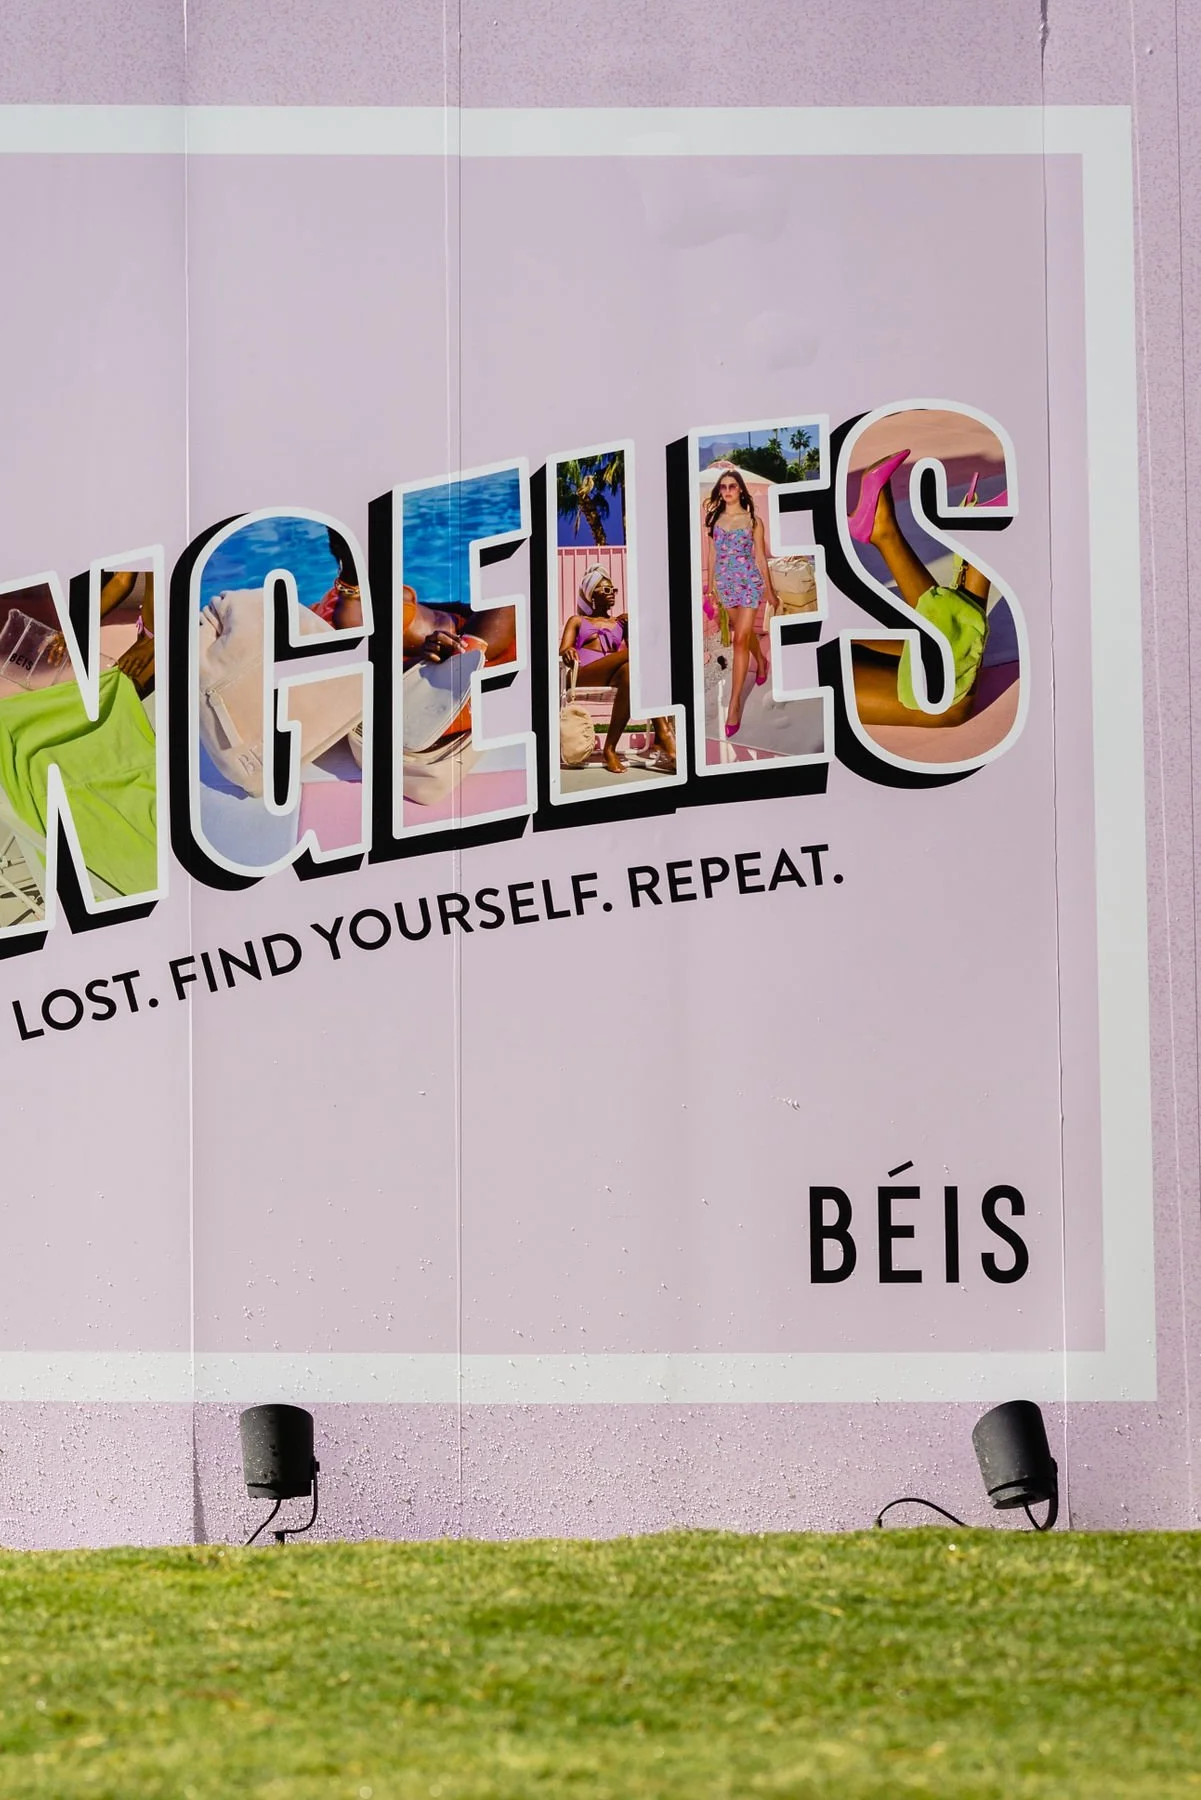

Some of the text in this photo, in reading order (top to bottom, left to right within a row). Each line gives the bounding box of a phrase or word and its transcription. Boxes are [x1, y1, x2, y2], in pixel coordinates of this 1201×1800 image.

[12, 970, 158, 1040] LOST.
[169, 934, 302, 1000] FIND
[311, 873, 613, 960] YOURSELF.
[628, 844, 844, 907] REPEAT.
[810, 1161, 1029, 1283] BÉIS
